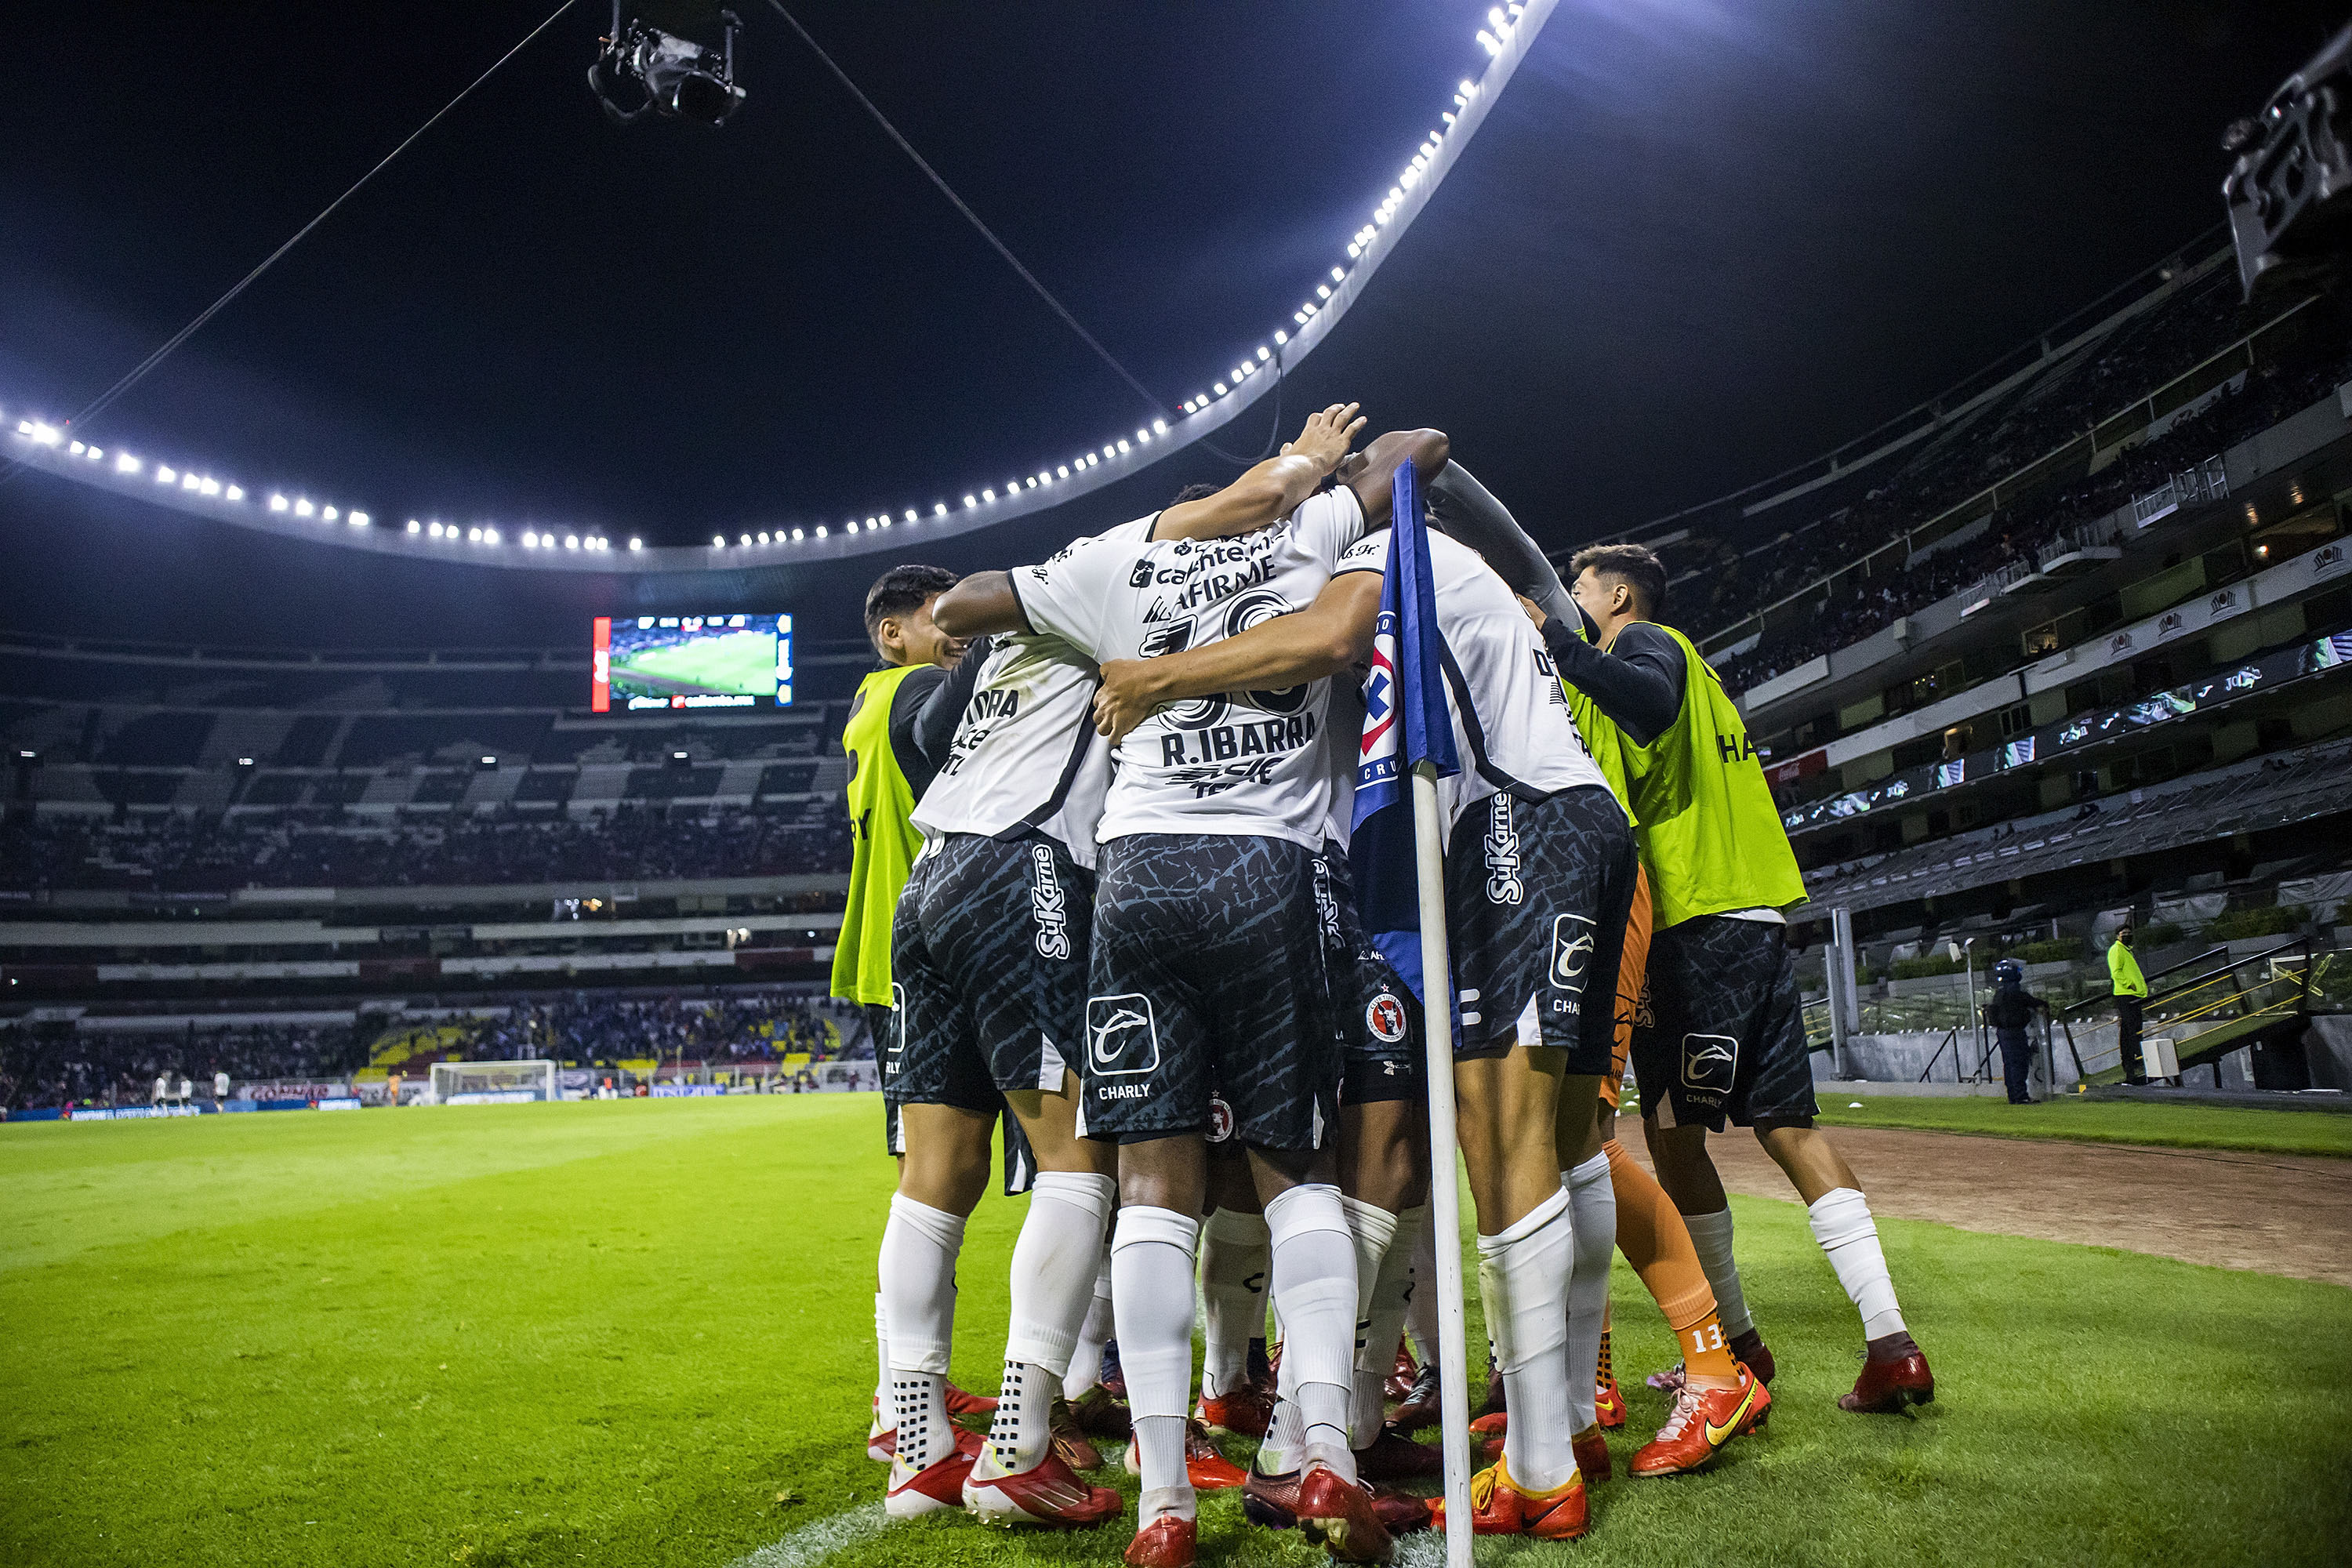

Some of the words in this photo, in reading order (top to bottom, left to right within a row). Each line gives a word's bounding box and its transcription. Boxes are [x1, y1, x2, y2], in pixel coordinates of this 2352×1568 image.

[1160, 711, 1316, 768] R.IBARRA
[1032, 844, 1070, 960] SuKarne
[1098, 1082, 1150, 1101] CHARLY
[1692, 1323, 1723, 1354] 13
